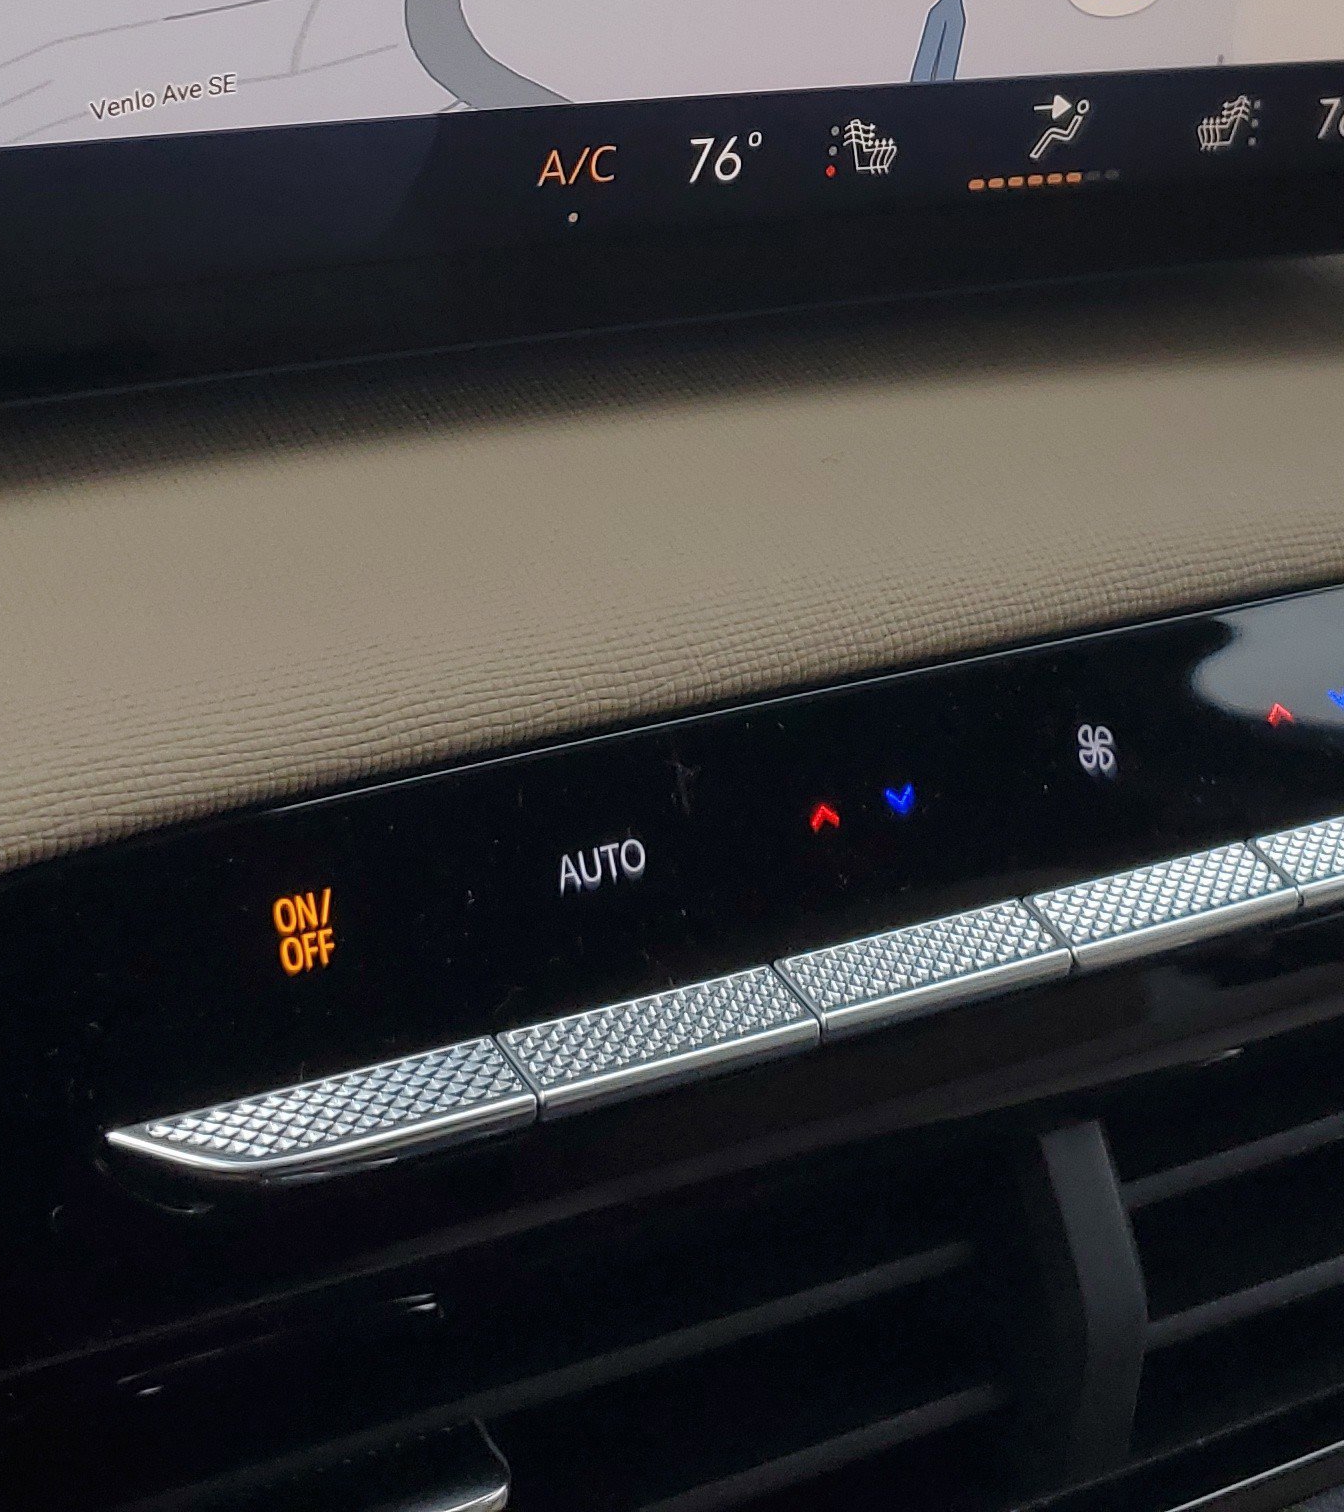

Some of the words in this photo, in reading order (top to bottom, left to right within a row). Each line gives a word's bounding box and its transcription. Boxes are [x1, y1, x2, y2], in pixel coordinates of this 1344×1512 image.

[88, 88, 156, 122] Venlo
[162, 78, 204, 105] Ave
[207, 73, 238, 97] SE
[537, 145, 617, 187] A/C
[689, 131, 762, 184] 76°
[558, 838, 647, 897] AUTO
[273, 889, 331, 935] ON/
[279, 929, 336, 976] OFF
